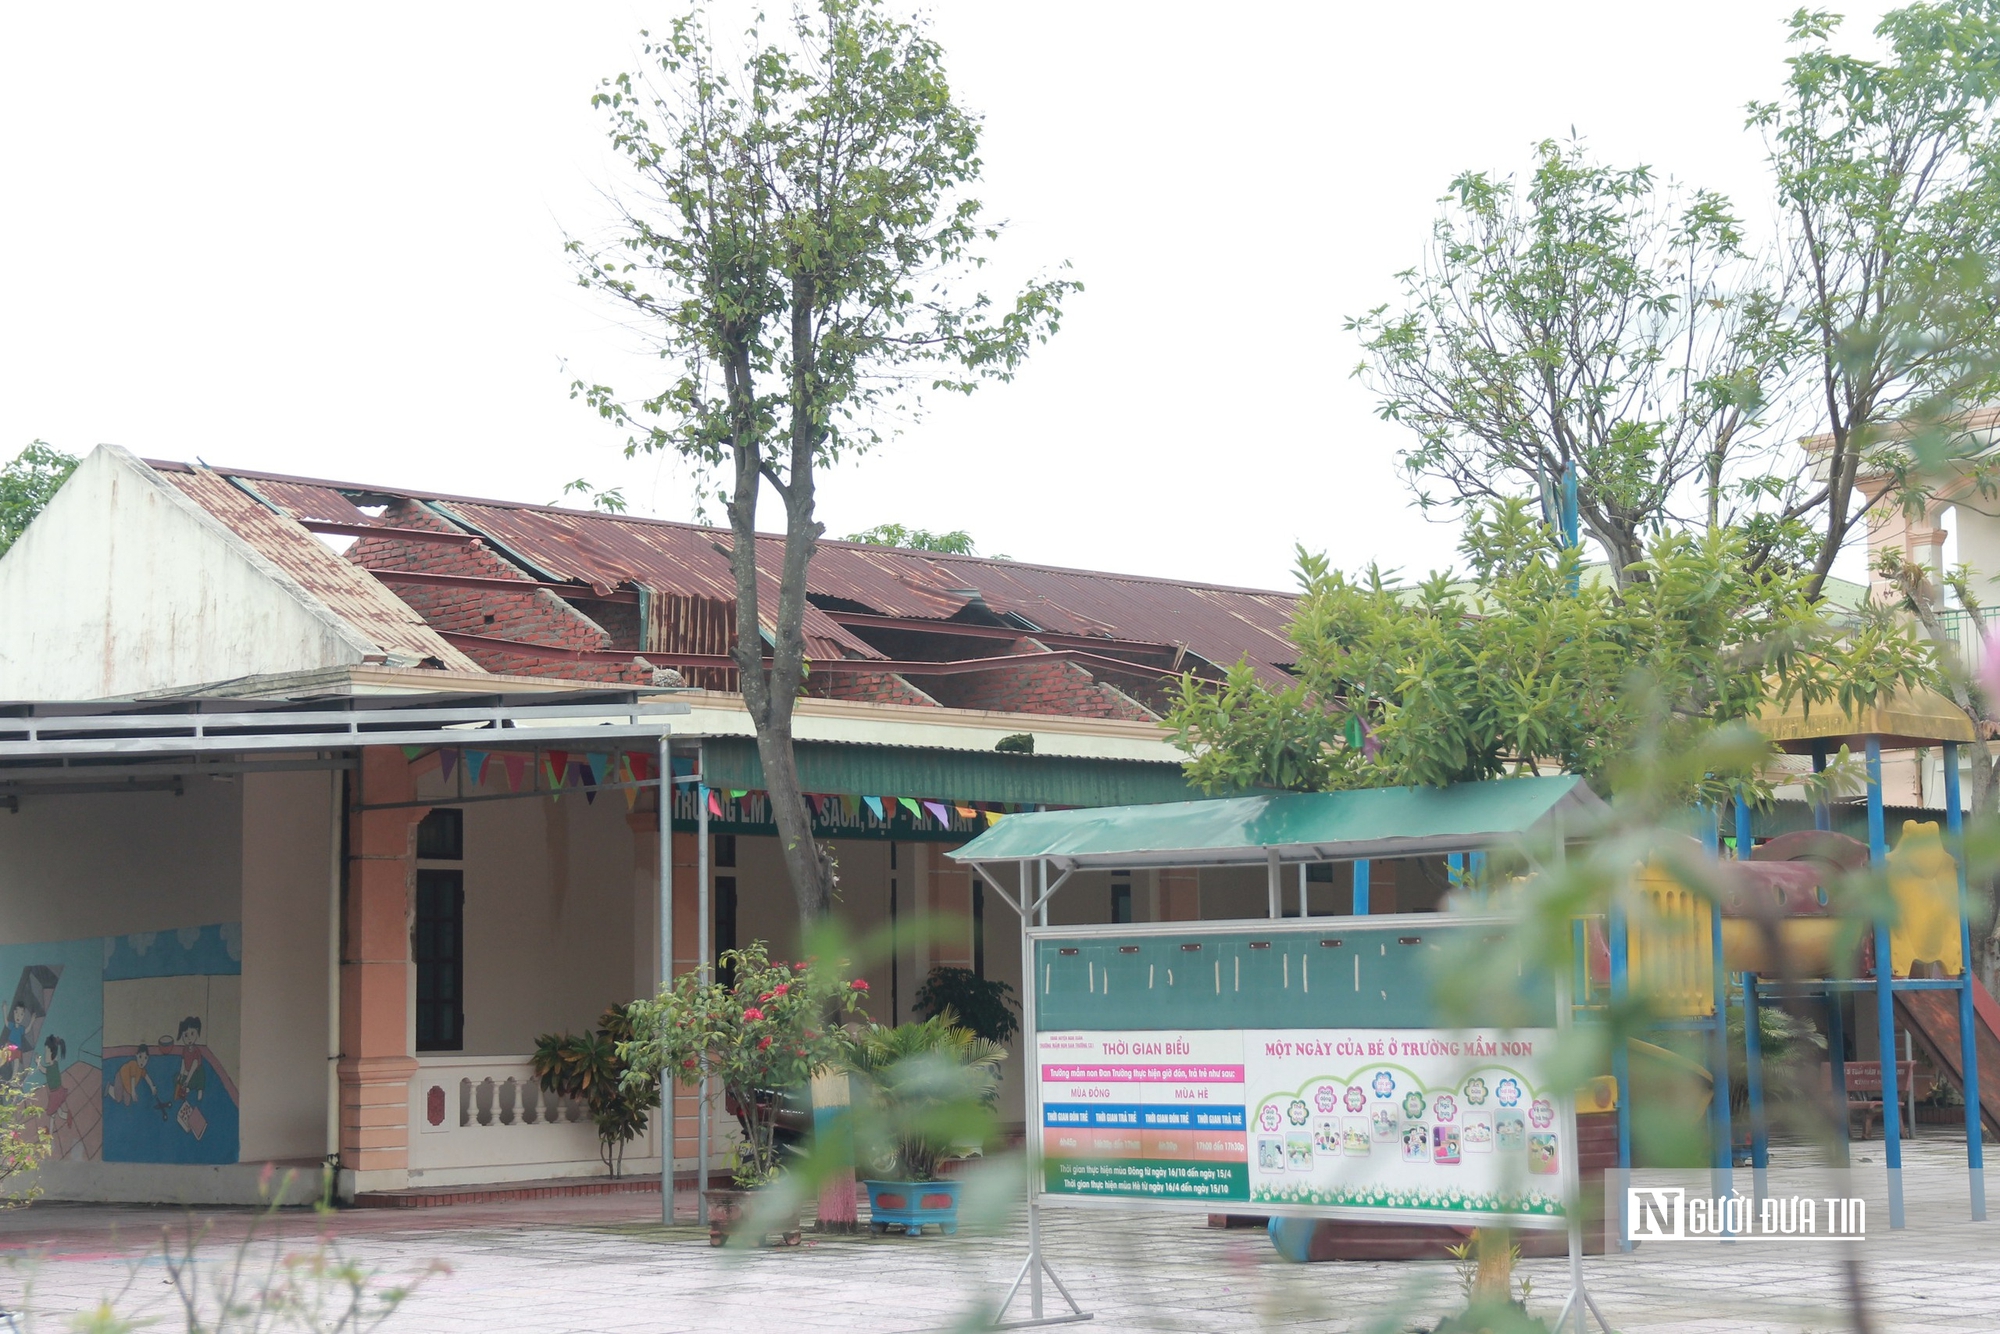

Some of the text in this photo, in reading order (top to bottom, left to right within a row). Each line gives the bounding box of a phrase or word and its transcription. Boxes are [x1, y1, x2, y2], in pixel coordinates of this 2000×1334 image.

[674, 789, 736, 823] TRNG
[1102, 1035, 1190, 1055] THỜI GIAN BIỂU
[1265, 1035, 1533, 1059] MỘT NGÀY CỦA BÉ Ở TRƯỜNG MẦM NON
[1086, 1069, 1098, 1077] non
[1070, 1086, 1111, 1098] MÙA ĐÔNG
[1175, 1087, 1209, 1099] MÙA HÈ
[1168, 1168, 1186, 1178] 16/10
[1216, 1169, 1232, 1178] 15/4
[1165, 1182, 1180, 1192] 16/4
[1210, 1184, 1229, 1194] 15/10
